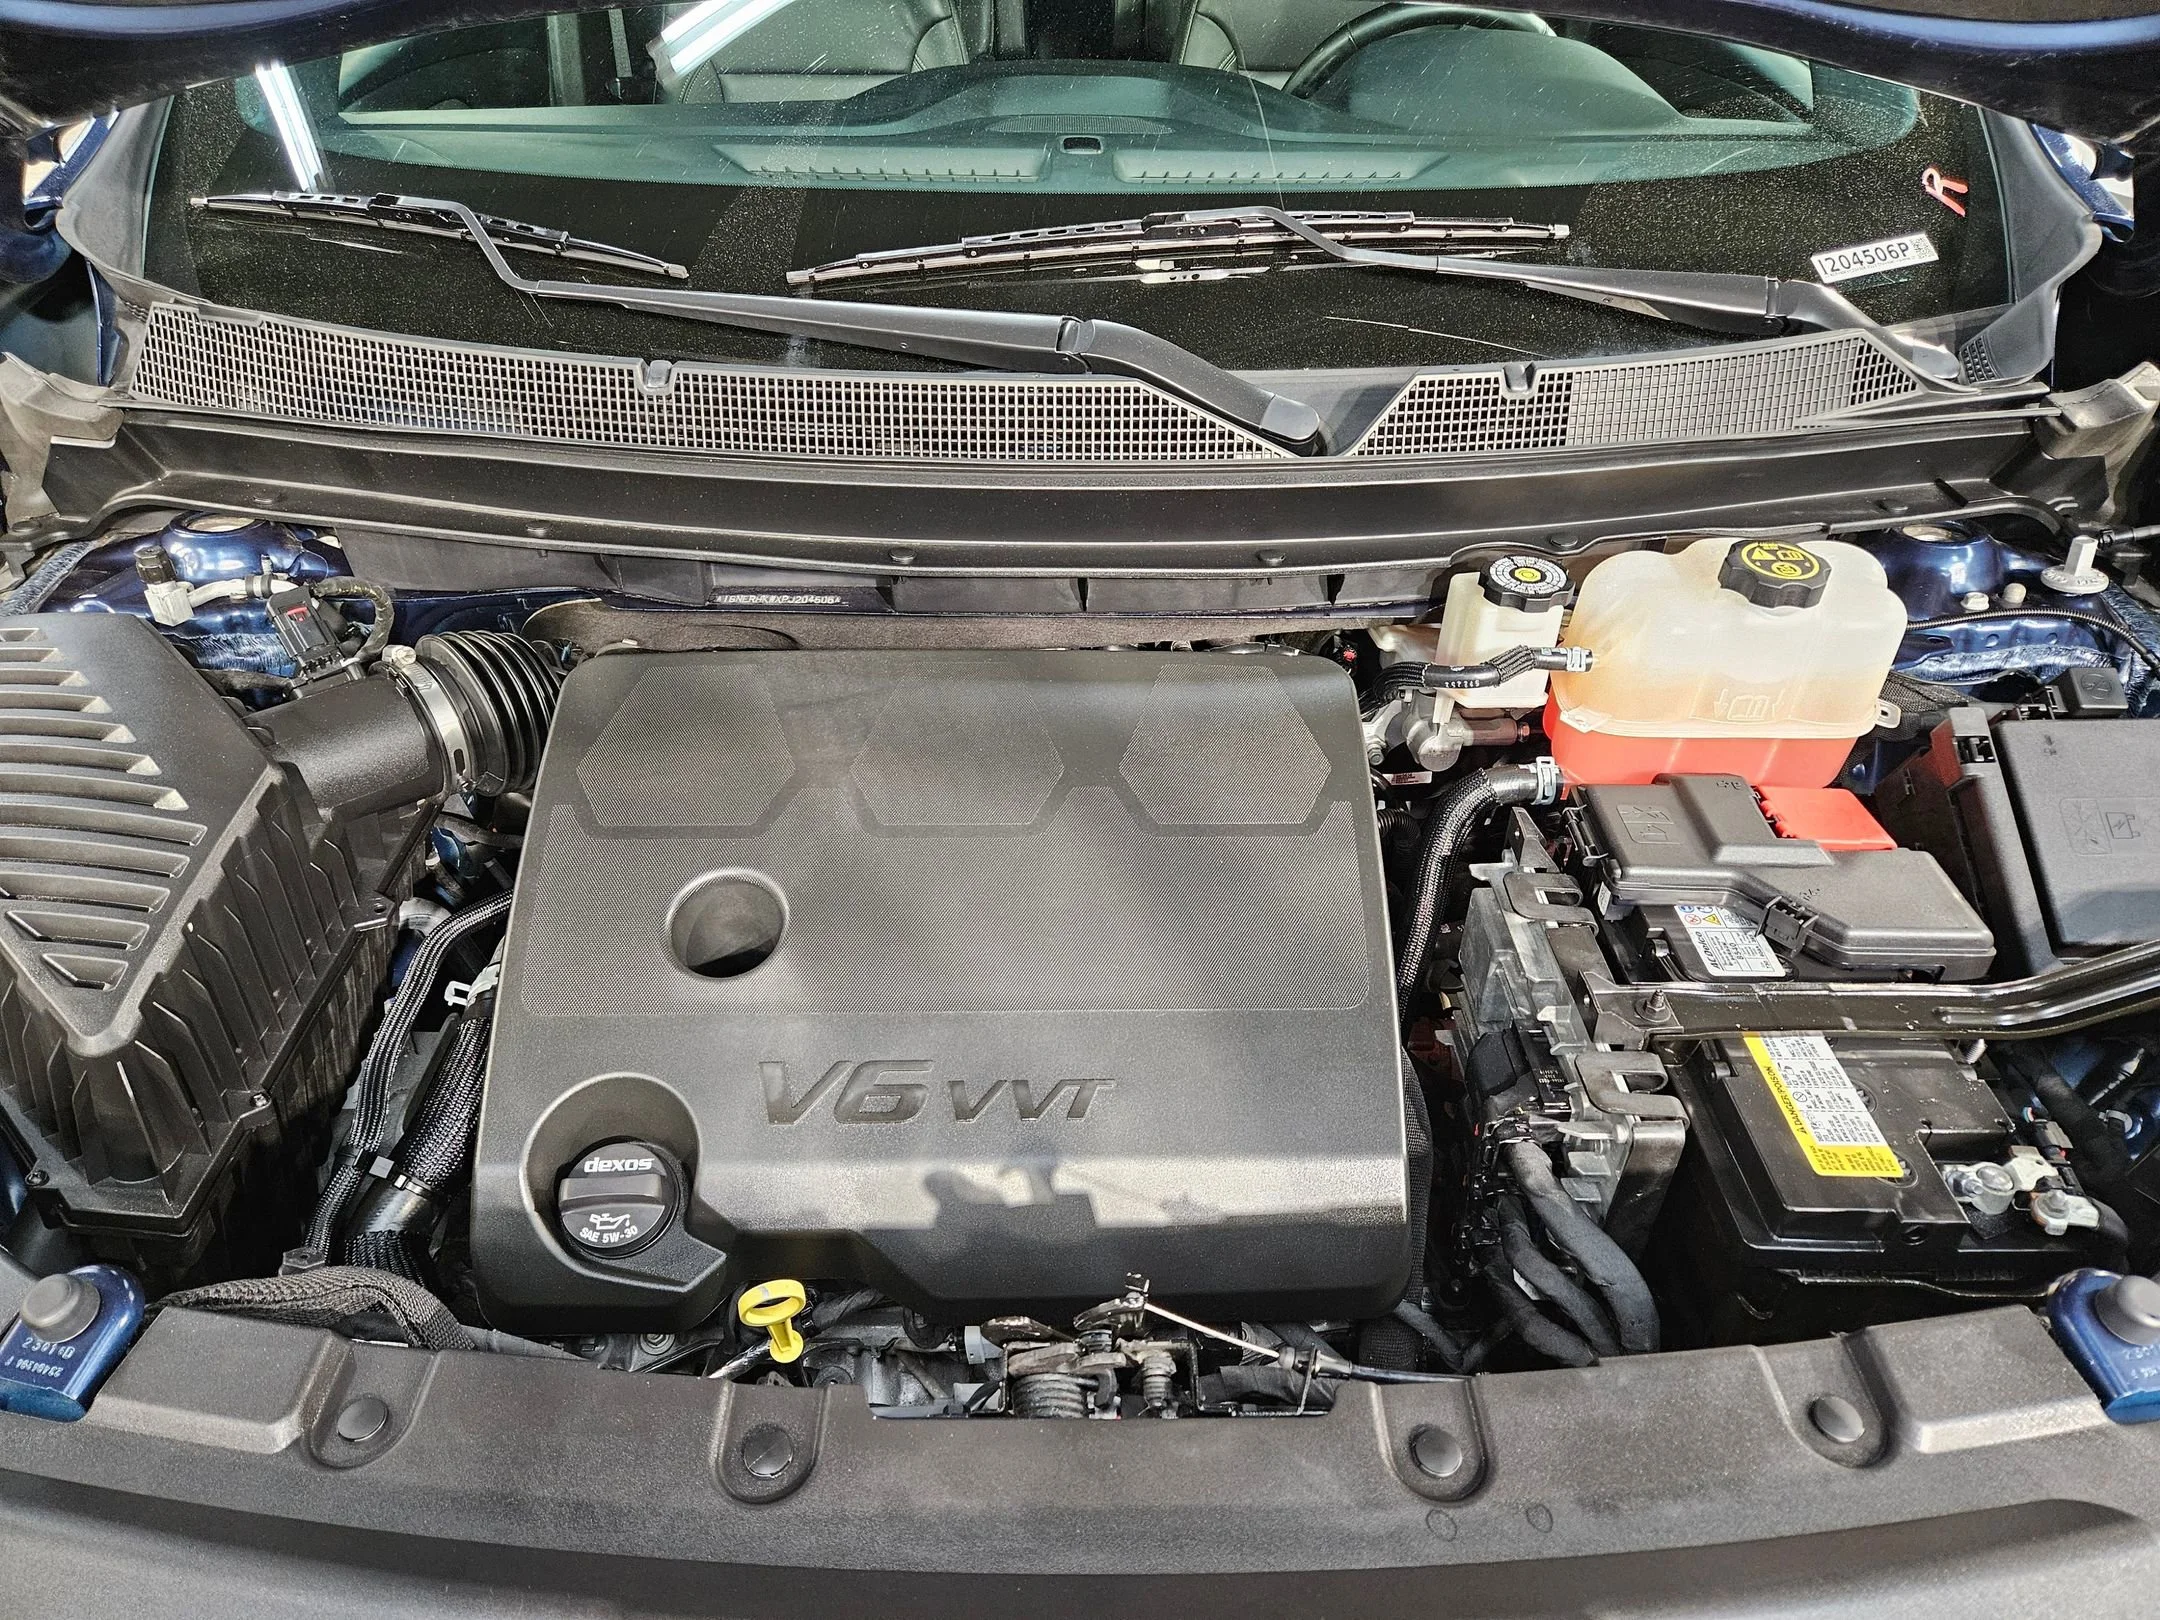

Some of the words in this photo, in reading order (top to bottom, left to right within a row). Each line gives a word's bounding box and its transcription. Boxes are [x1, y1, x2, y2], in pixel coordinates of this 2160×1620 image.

[758, 1060, 934, 1126] V6
[947, 1078, 1116, 1122] VVT
[584, 1157, 656, 1173] dexos
[579, 1227, 601, 1243] SAE
[602, 1225, 639, 1244] 5W-30
